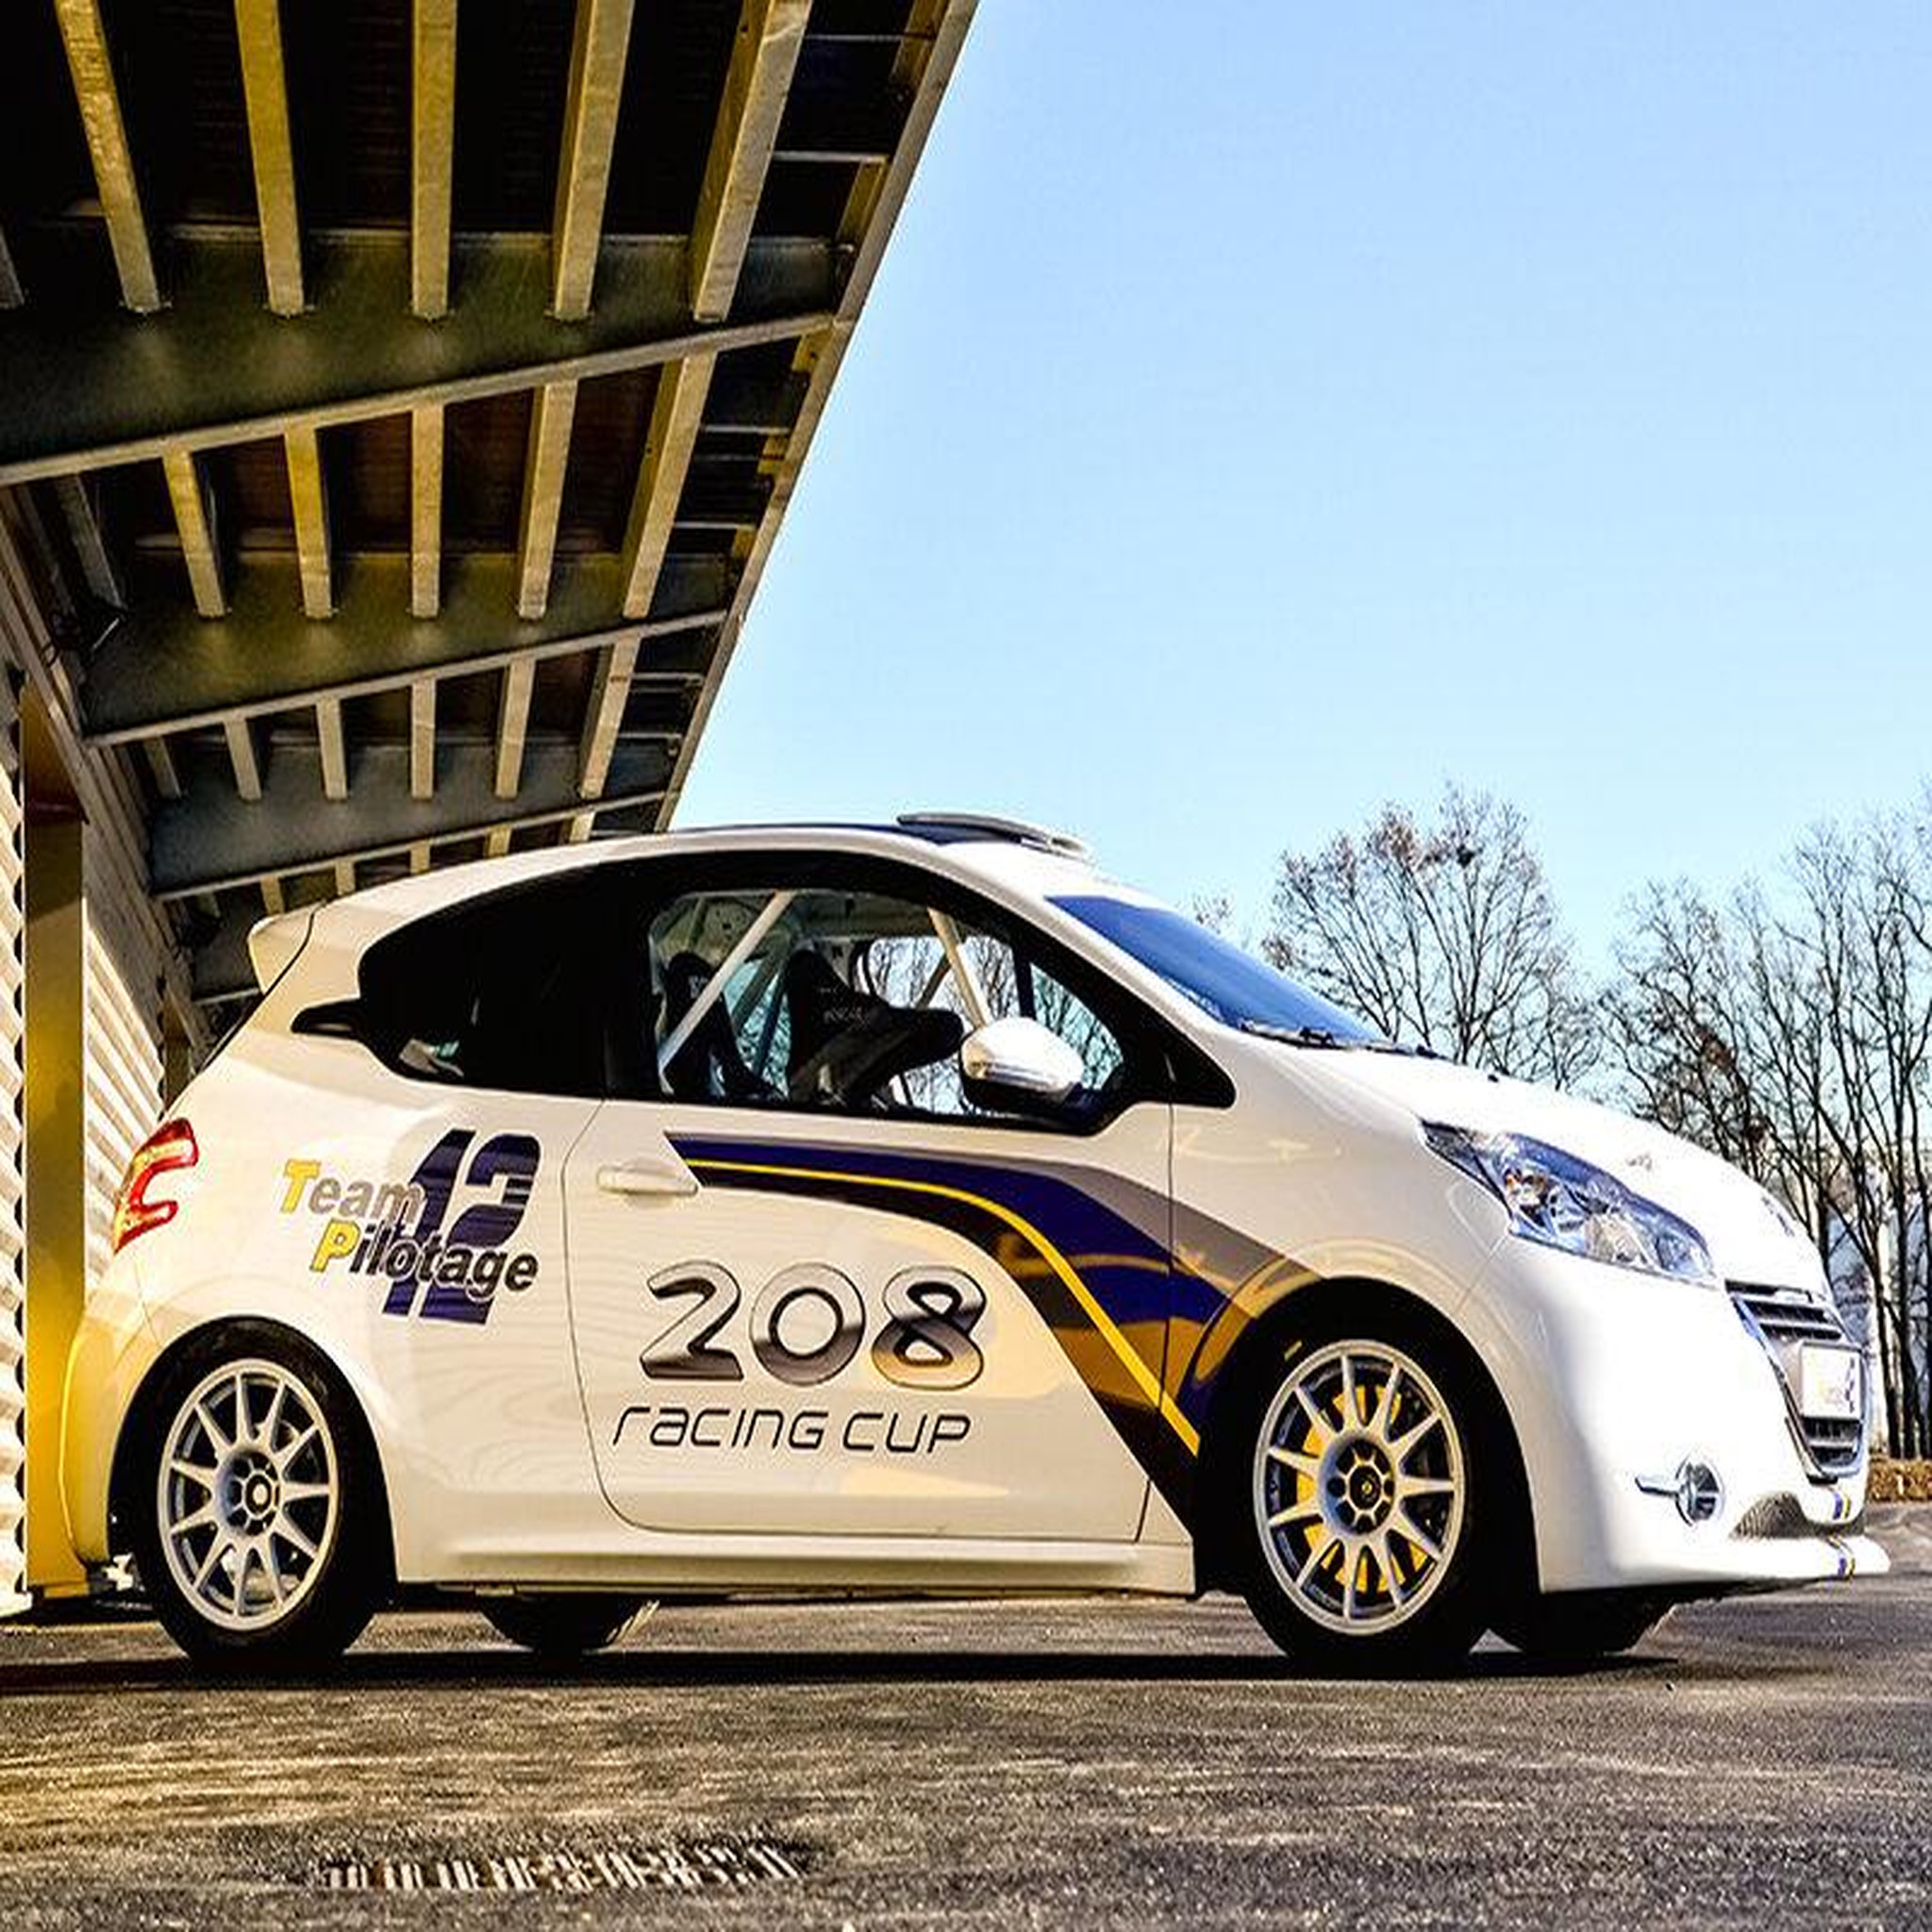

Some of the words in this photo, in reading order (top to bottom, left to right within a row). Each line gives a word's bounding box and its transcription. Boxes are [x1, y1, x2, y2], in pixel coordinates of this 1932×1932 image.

[280, 1158, 425, 1225] Team
[382, 1128, 541, 1325] 12
[309, 1218, 540, 1297] Pilotage
[639, 1258, 988, 1391] 208
[842, 1411, 973, 1454] CUP
